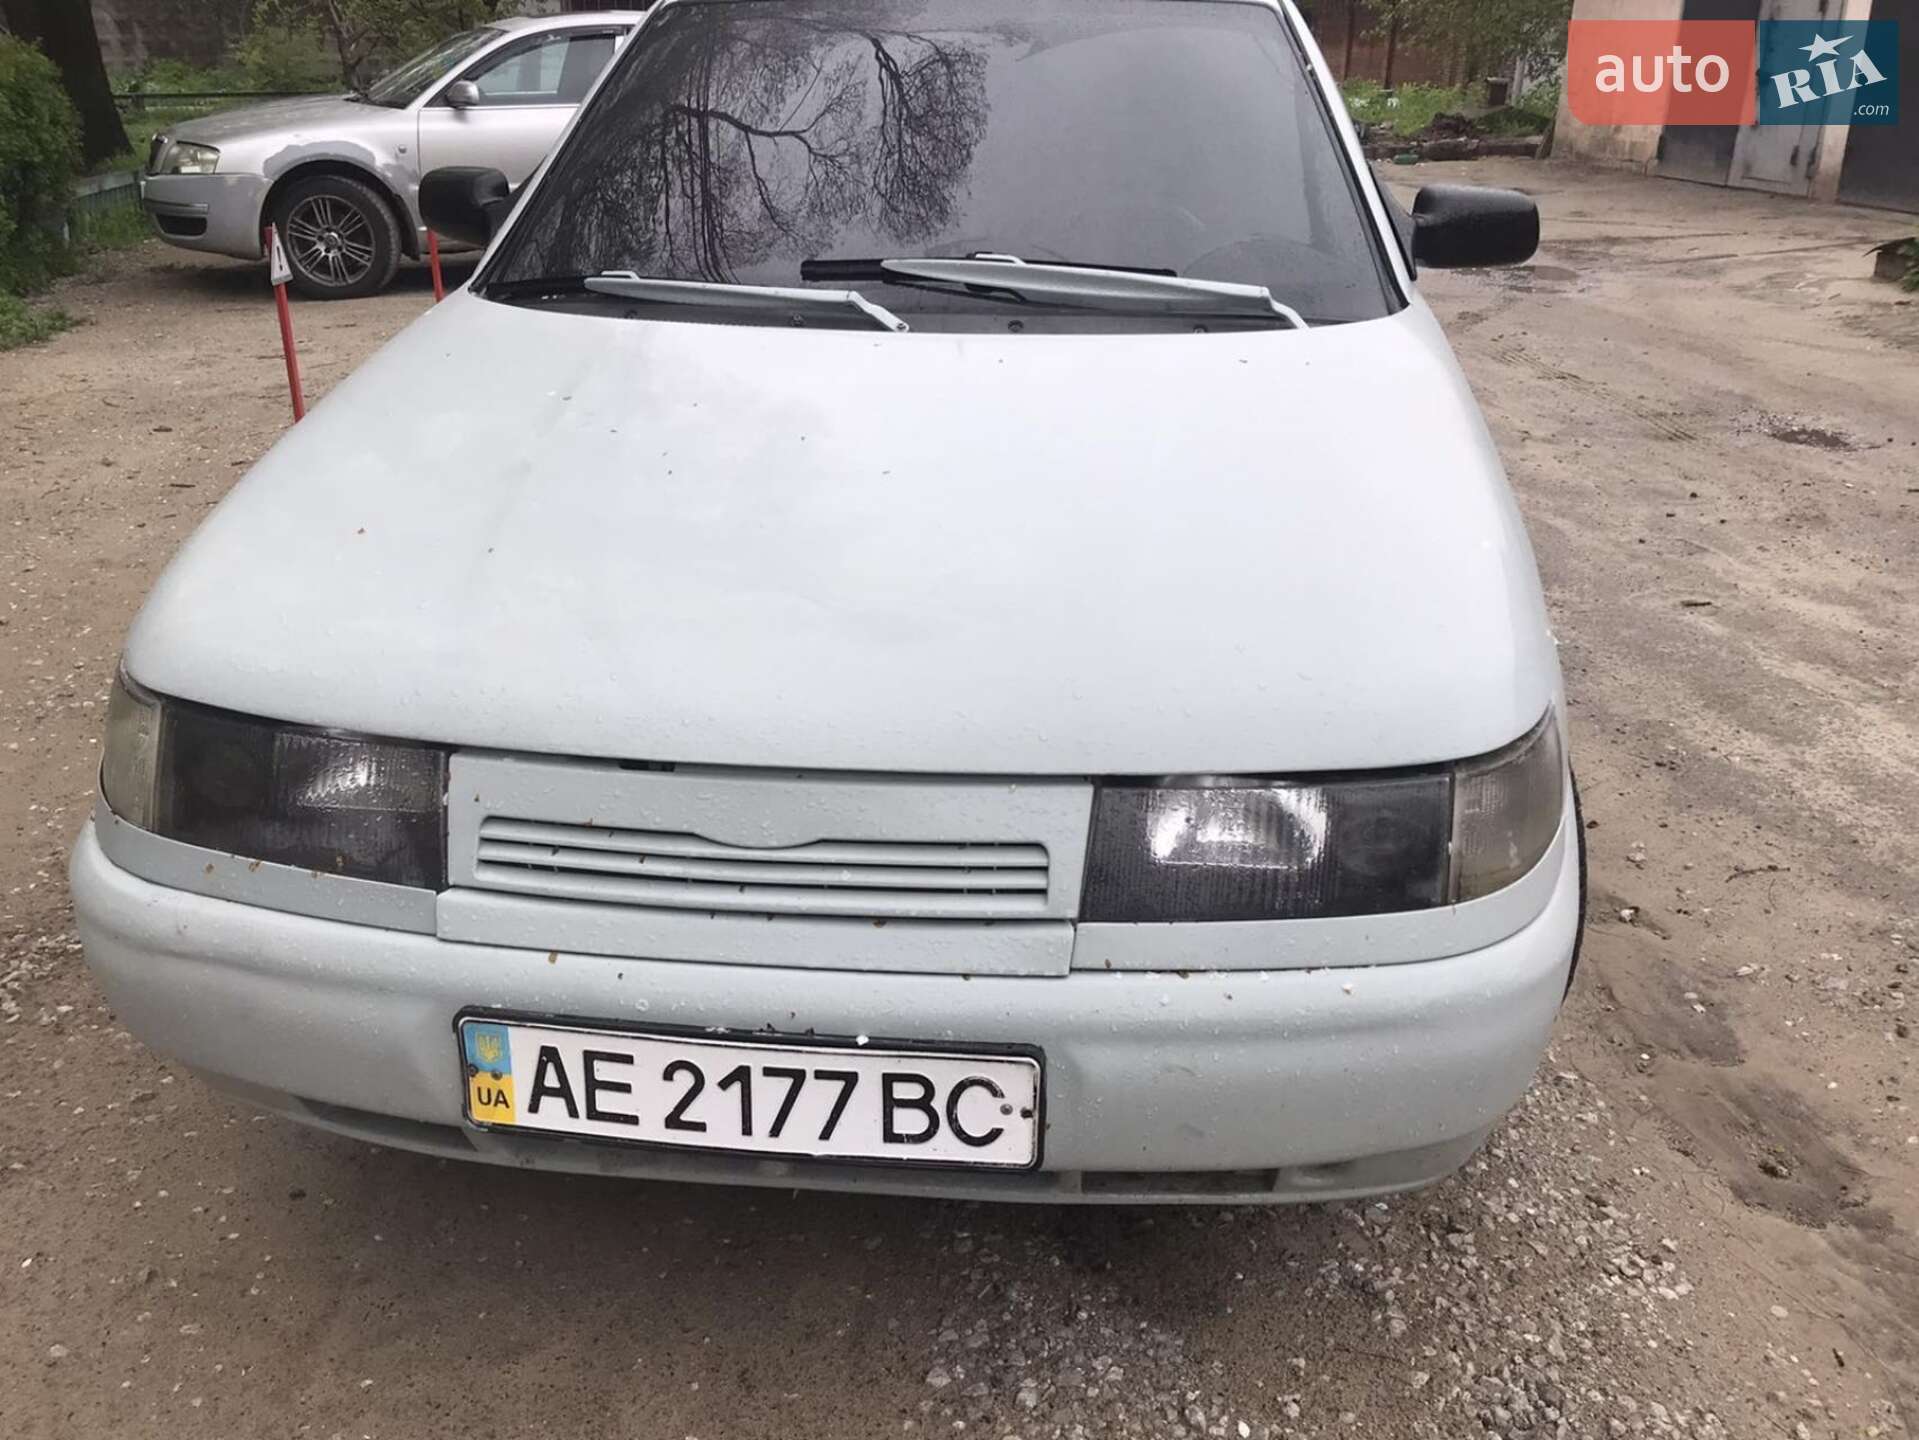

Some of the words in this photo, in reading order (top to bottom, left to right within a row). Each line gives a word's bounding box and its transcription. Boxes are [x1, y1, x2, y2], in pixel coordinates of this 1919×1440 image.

[477, 1087, 511, 1110] UA
[527, 1044, 640, 1126] AE
[661, 1059, 859, 1141] 2177
[881, 1072, 1006, 1148] BC
